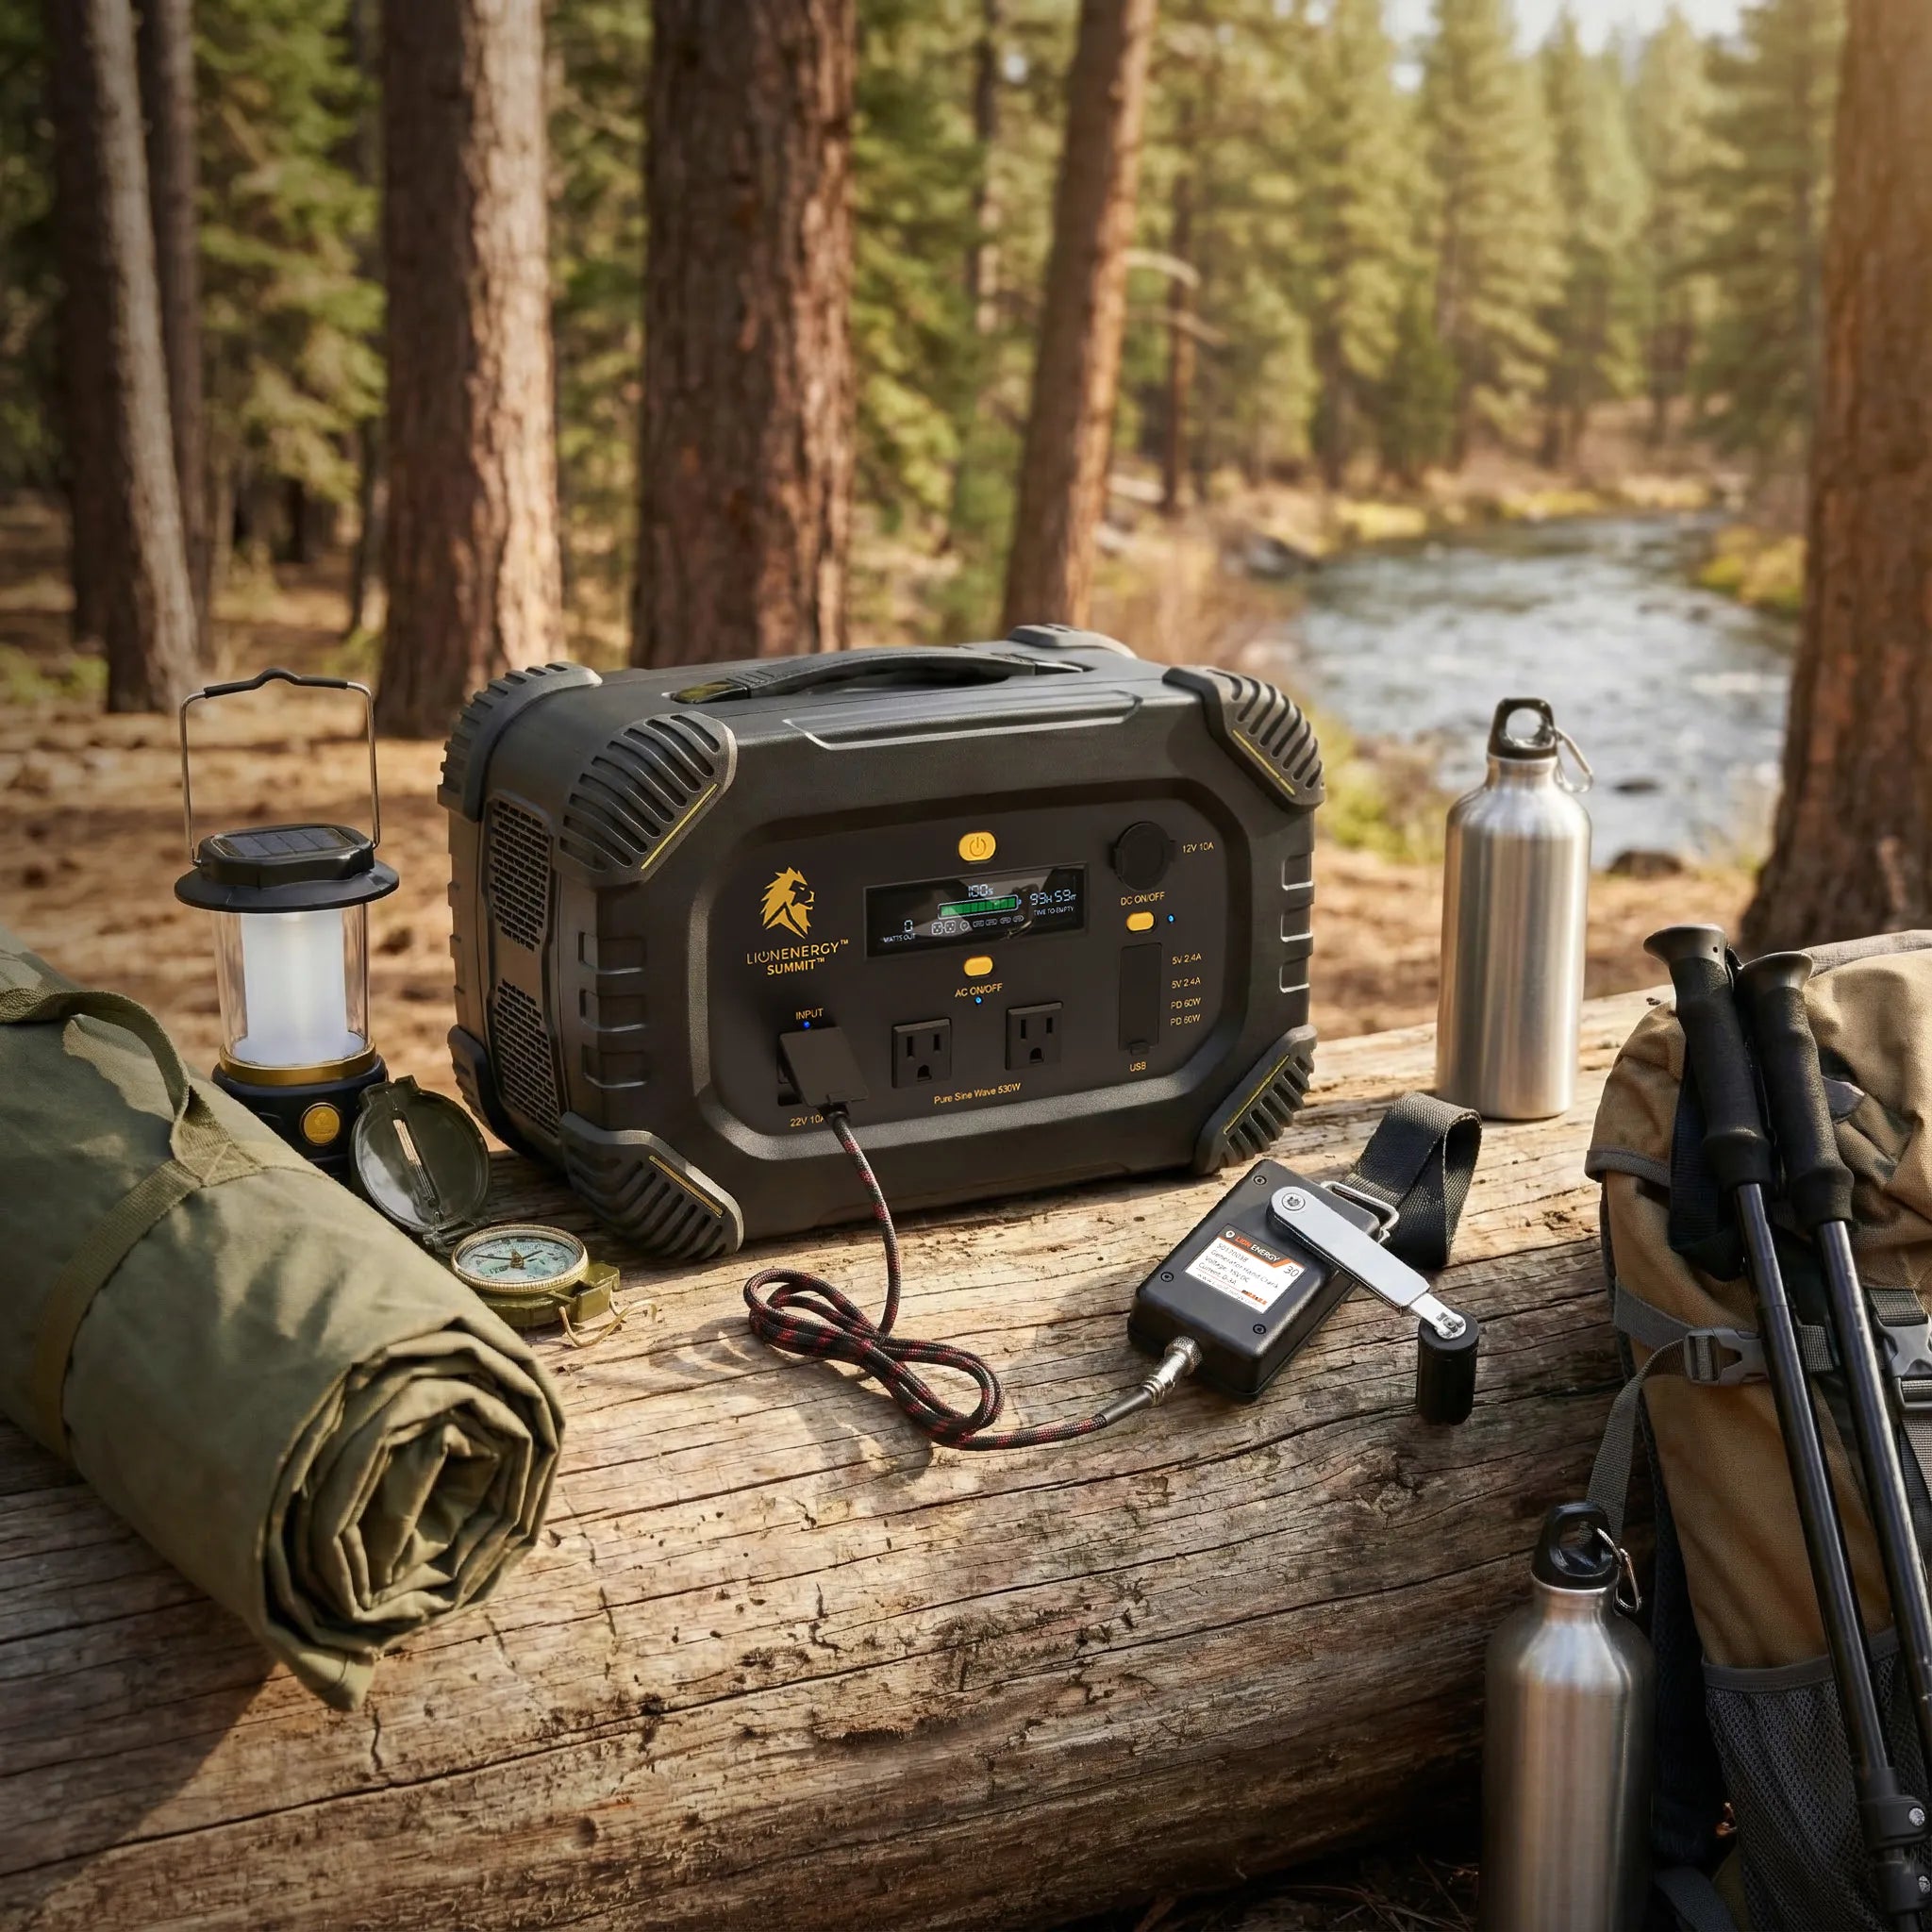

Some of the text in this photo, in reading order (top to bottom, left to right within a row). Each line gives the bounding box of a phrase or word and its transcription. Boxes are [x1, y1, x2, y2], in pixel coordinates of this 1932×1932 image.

[1183, 841, 1214, 853] 12V 10A
[1120, 891, 1165, 906] DC ON/OFF
[904, 920, 913, 932] 0
[883, 934, 903, 942] WATTS
[1172, 953, 1202, 965] 5V 2.4A
[1171, 977, 1201, 989] 5V 2.4A
[954, 983, 1003, 998] AC ON/OFF
[1170, 997, 1201, 1009] PD 60W
[795, 1008, 824, 1020] INPUT
[1170, 1014, 1200, 1026] PD 60W
[1129, 1061, 1147, 1072] USB
[934, 1083, 1021, 1104] Pure Sine Wave 530W
[790, 1116, 808, 1127] 22V
[1211, 1249, 1242, 1269] Generator
[1250, 1244, 1281, 1262] ENERGY
[1282, 1265, 1300, 1277] 30
